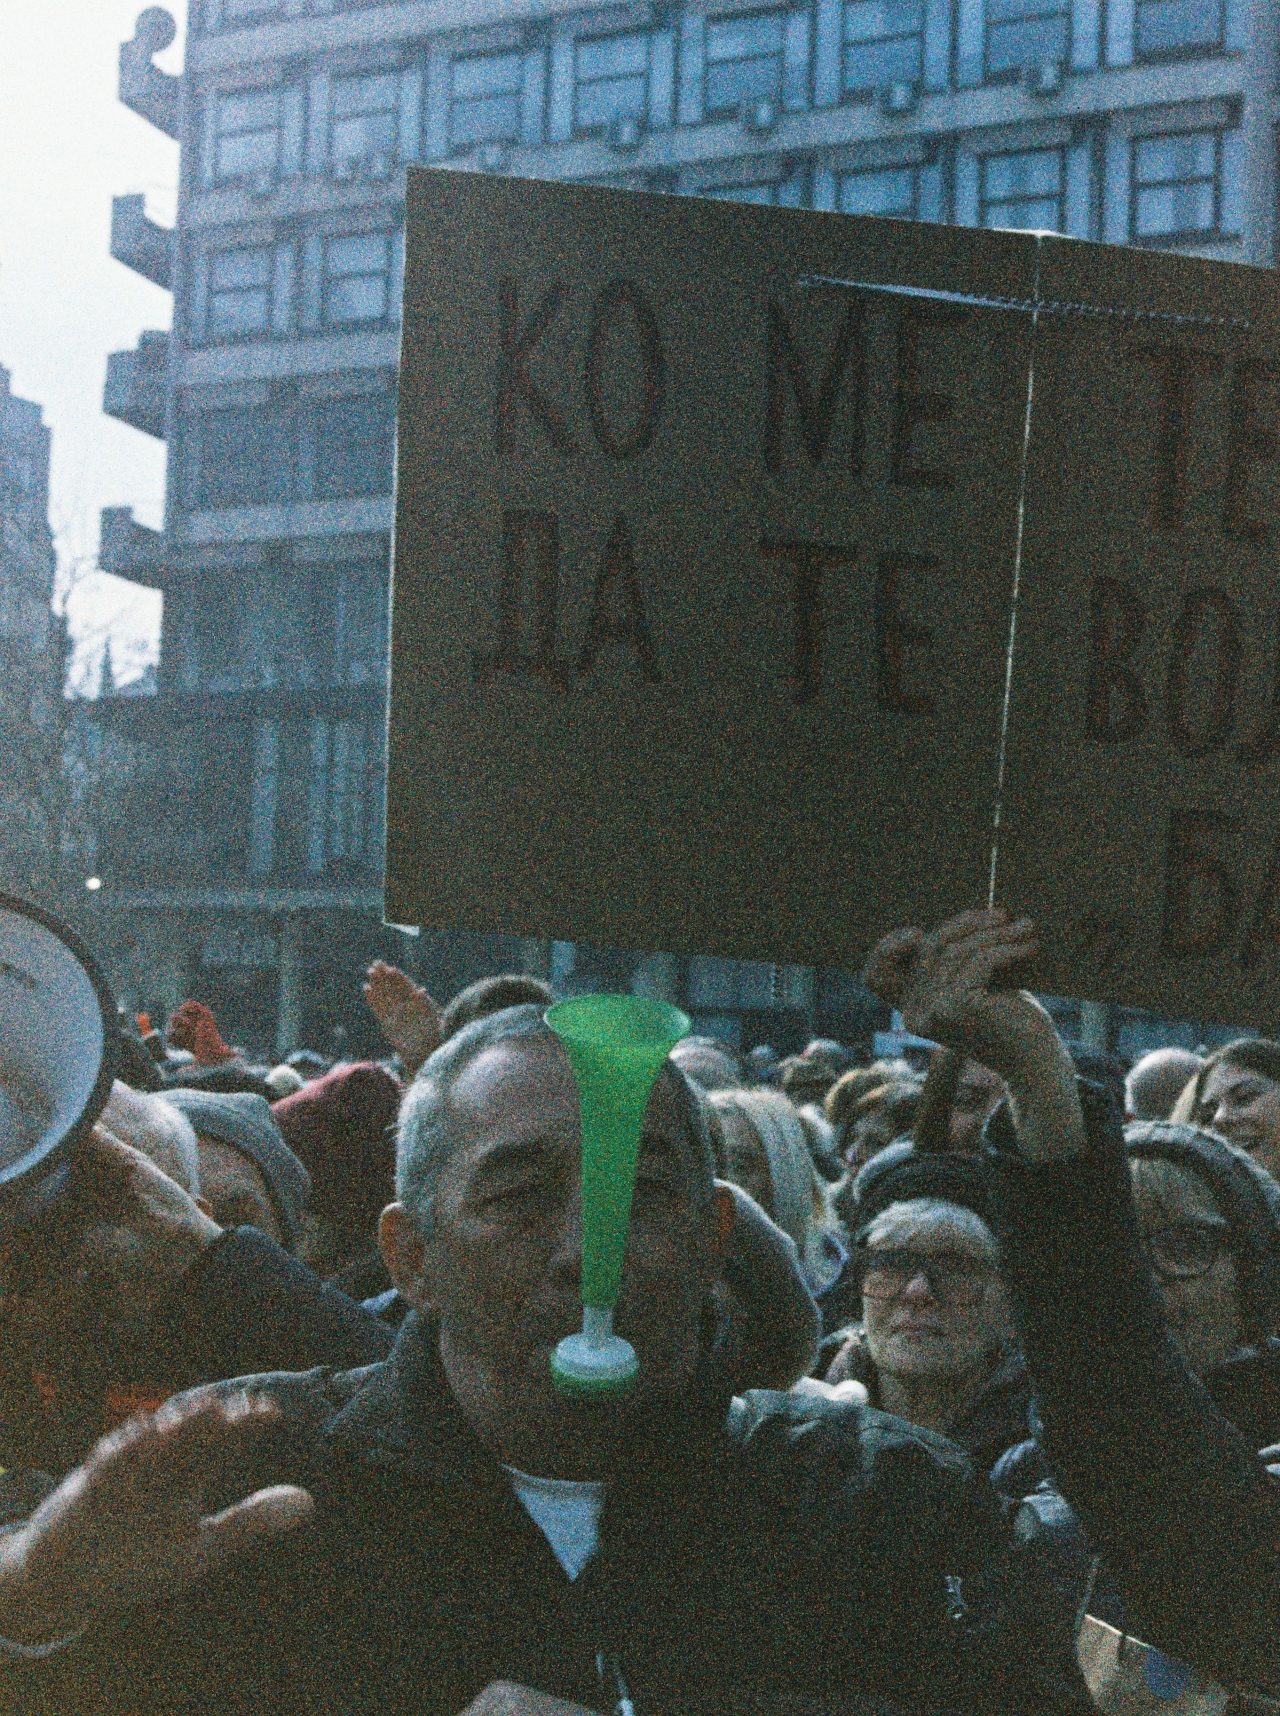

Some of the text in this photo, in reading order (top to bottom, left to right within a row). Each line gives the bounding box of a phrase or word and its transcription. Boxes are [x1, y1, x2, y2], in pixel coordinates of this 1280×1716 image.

[489, 275, 667, 461] КО
[762, 295, 968, 490] МЕ
[470, 508, 662, 694] ДА
[757, 537, 945, 717] ТЕ
